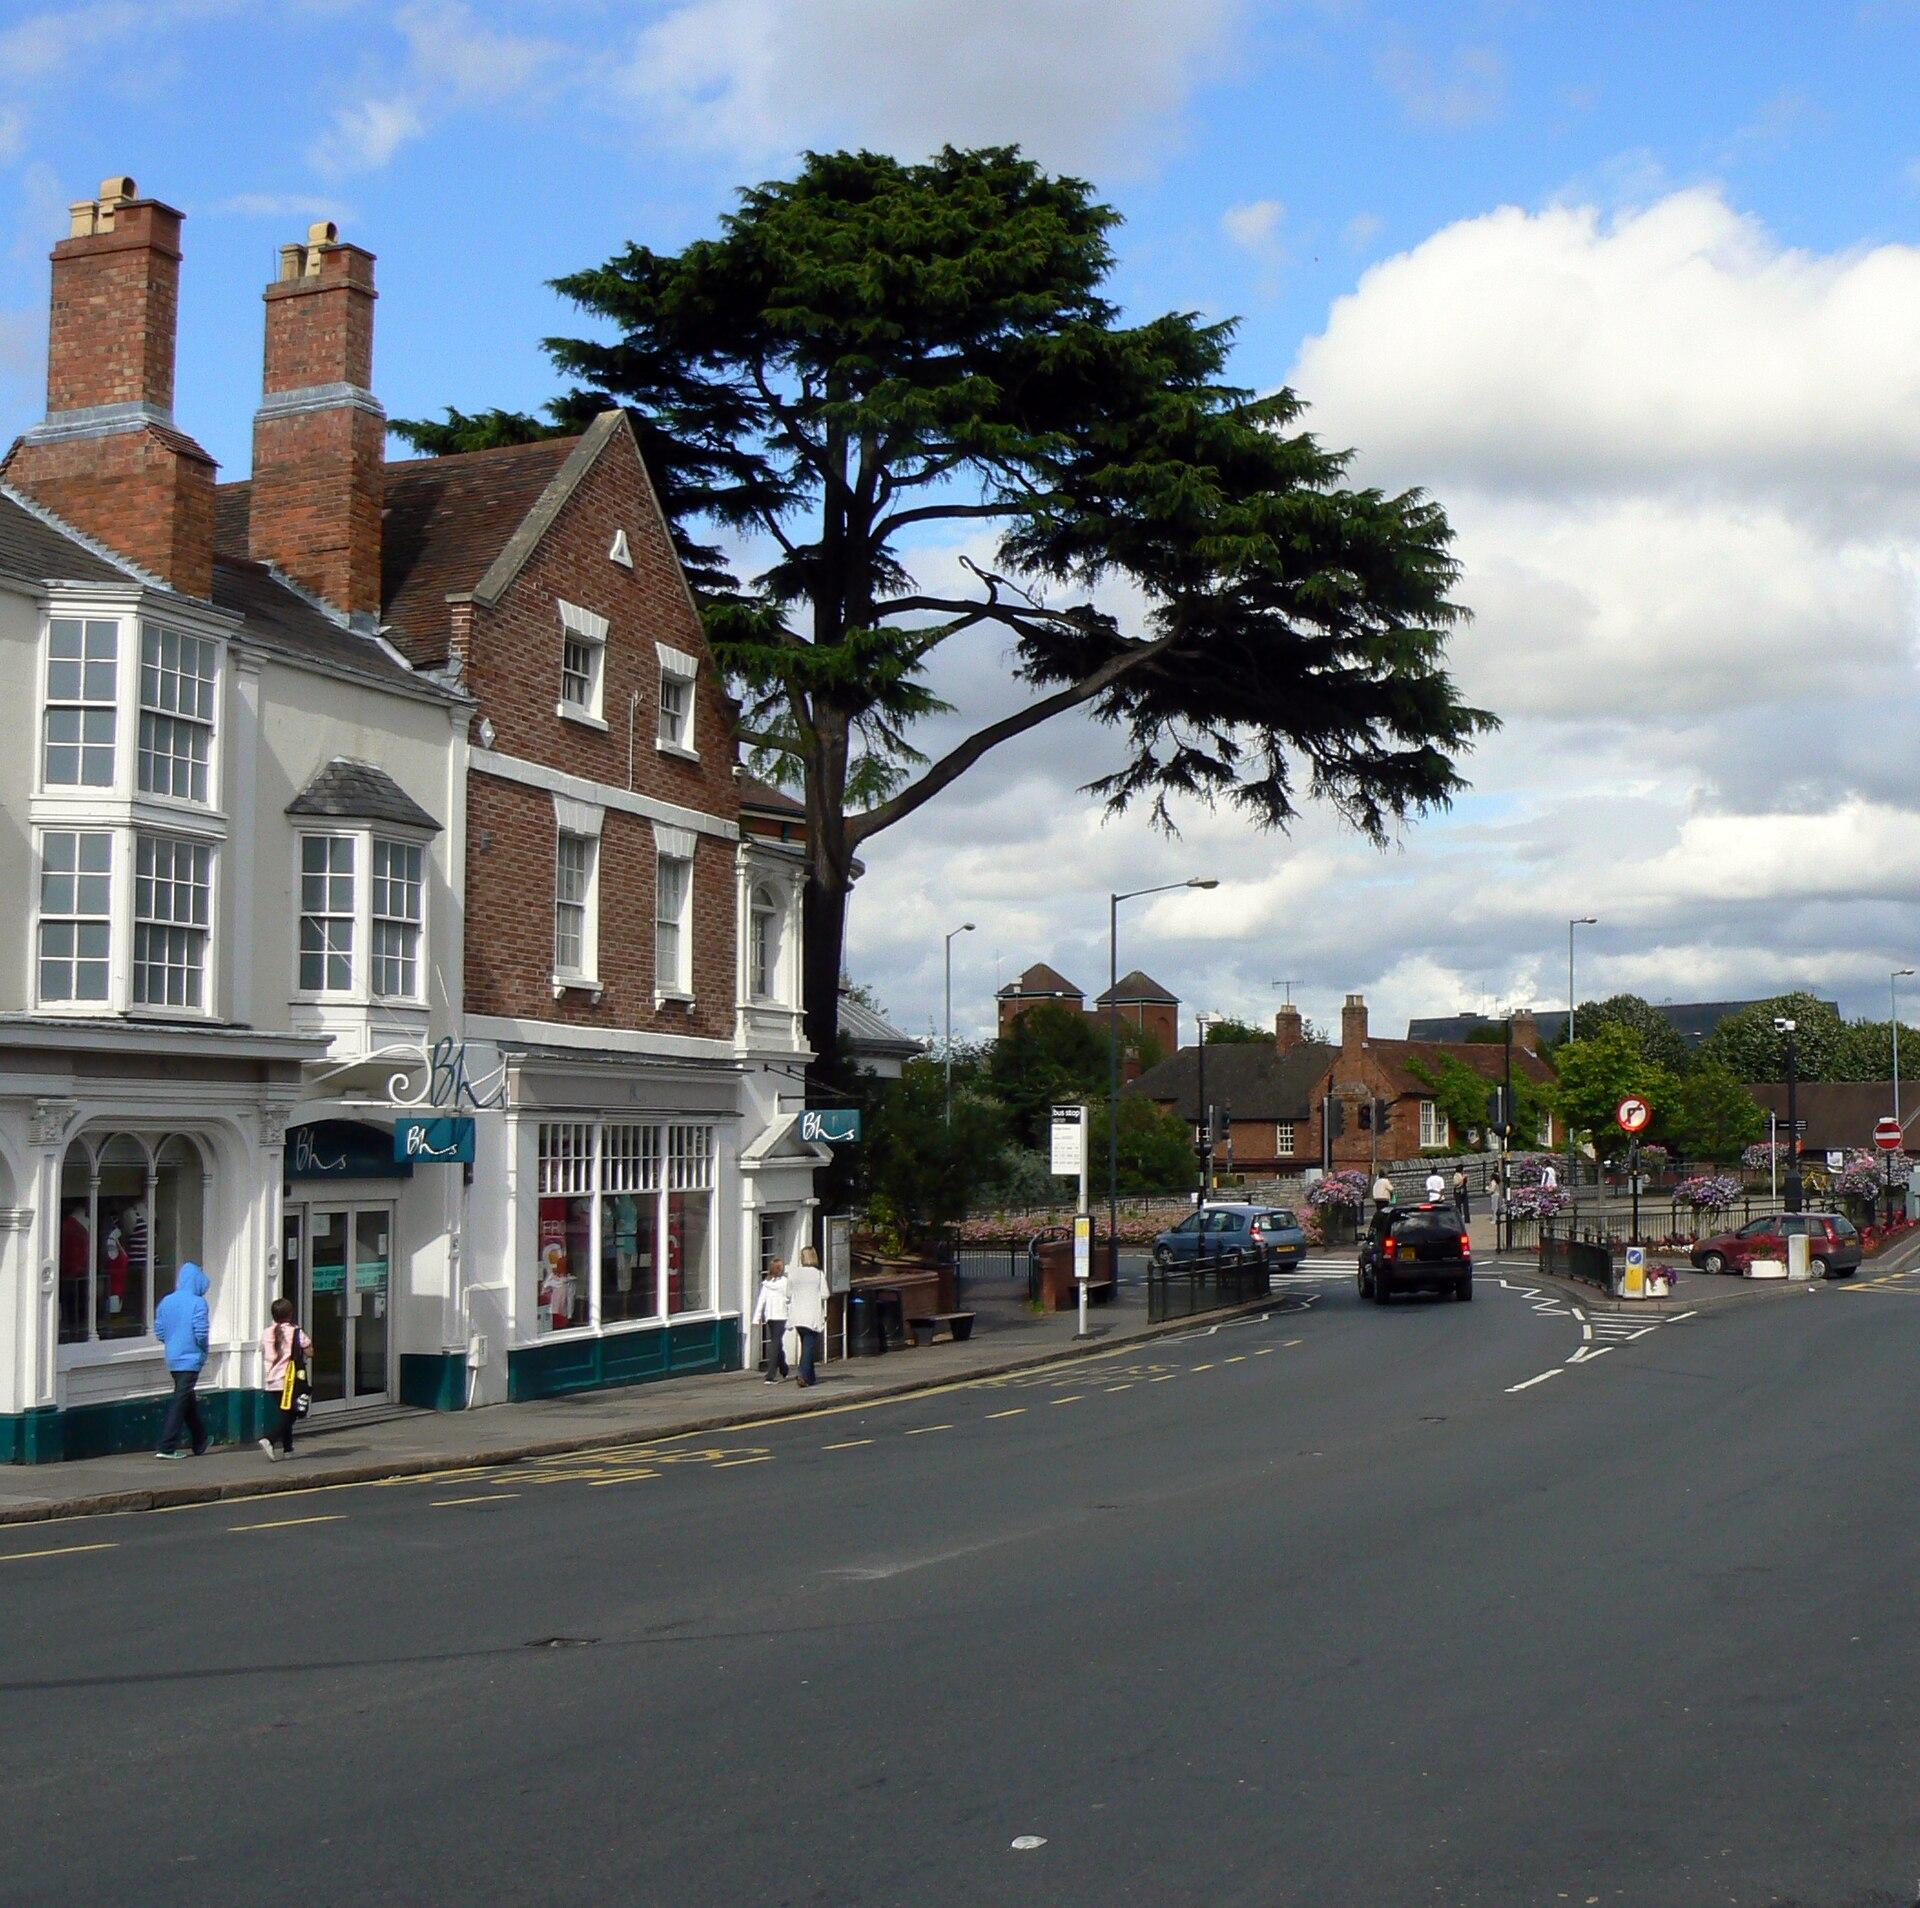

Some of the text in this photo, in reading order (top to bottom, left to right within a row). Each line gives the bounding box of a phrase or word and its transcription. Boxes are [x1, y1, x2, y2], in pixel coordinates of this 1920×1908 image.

[803, 1112, 855, 1140] Bhs
[1065, 1110, 1080, 1118] stop
[296, 1127, 347, 1171] Bhs
[406, 1125, 457, 1155] Bhs
